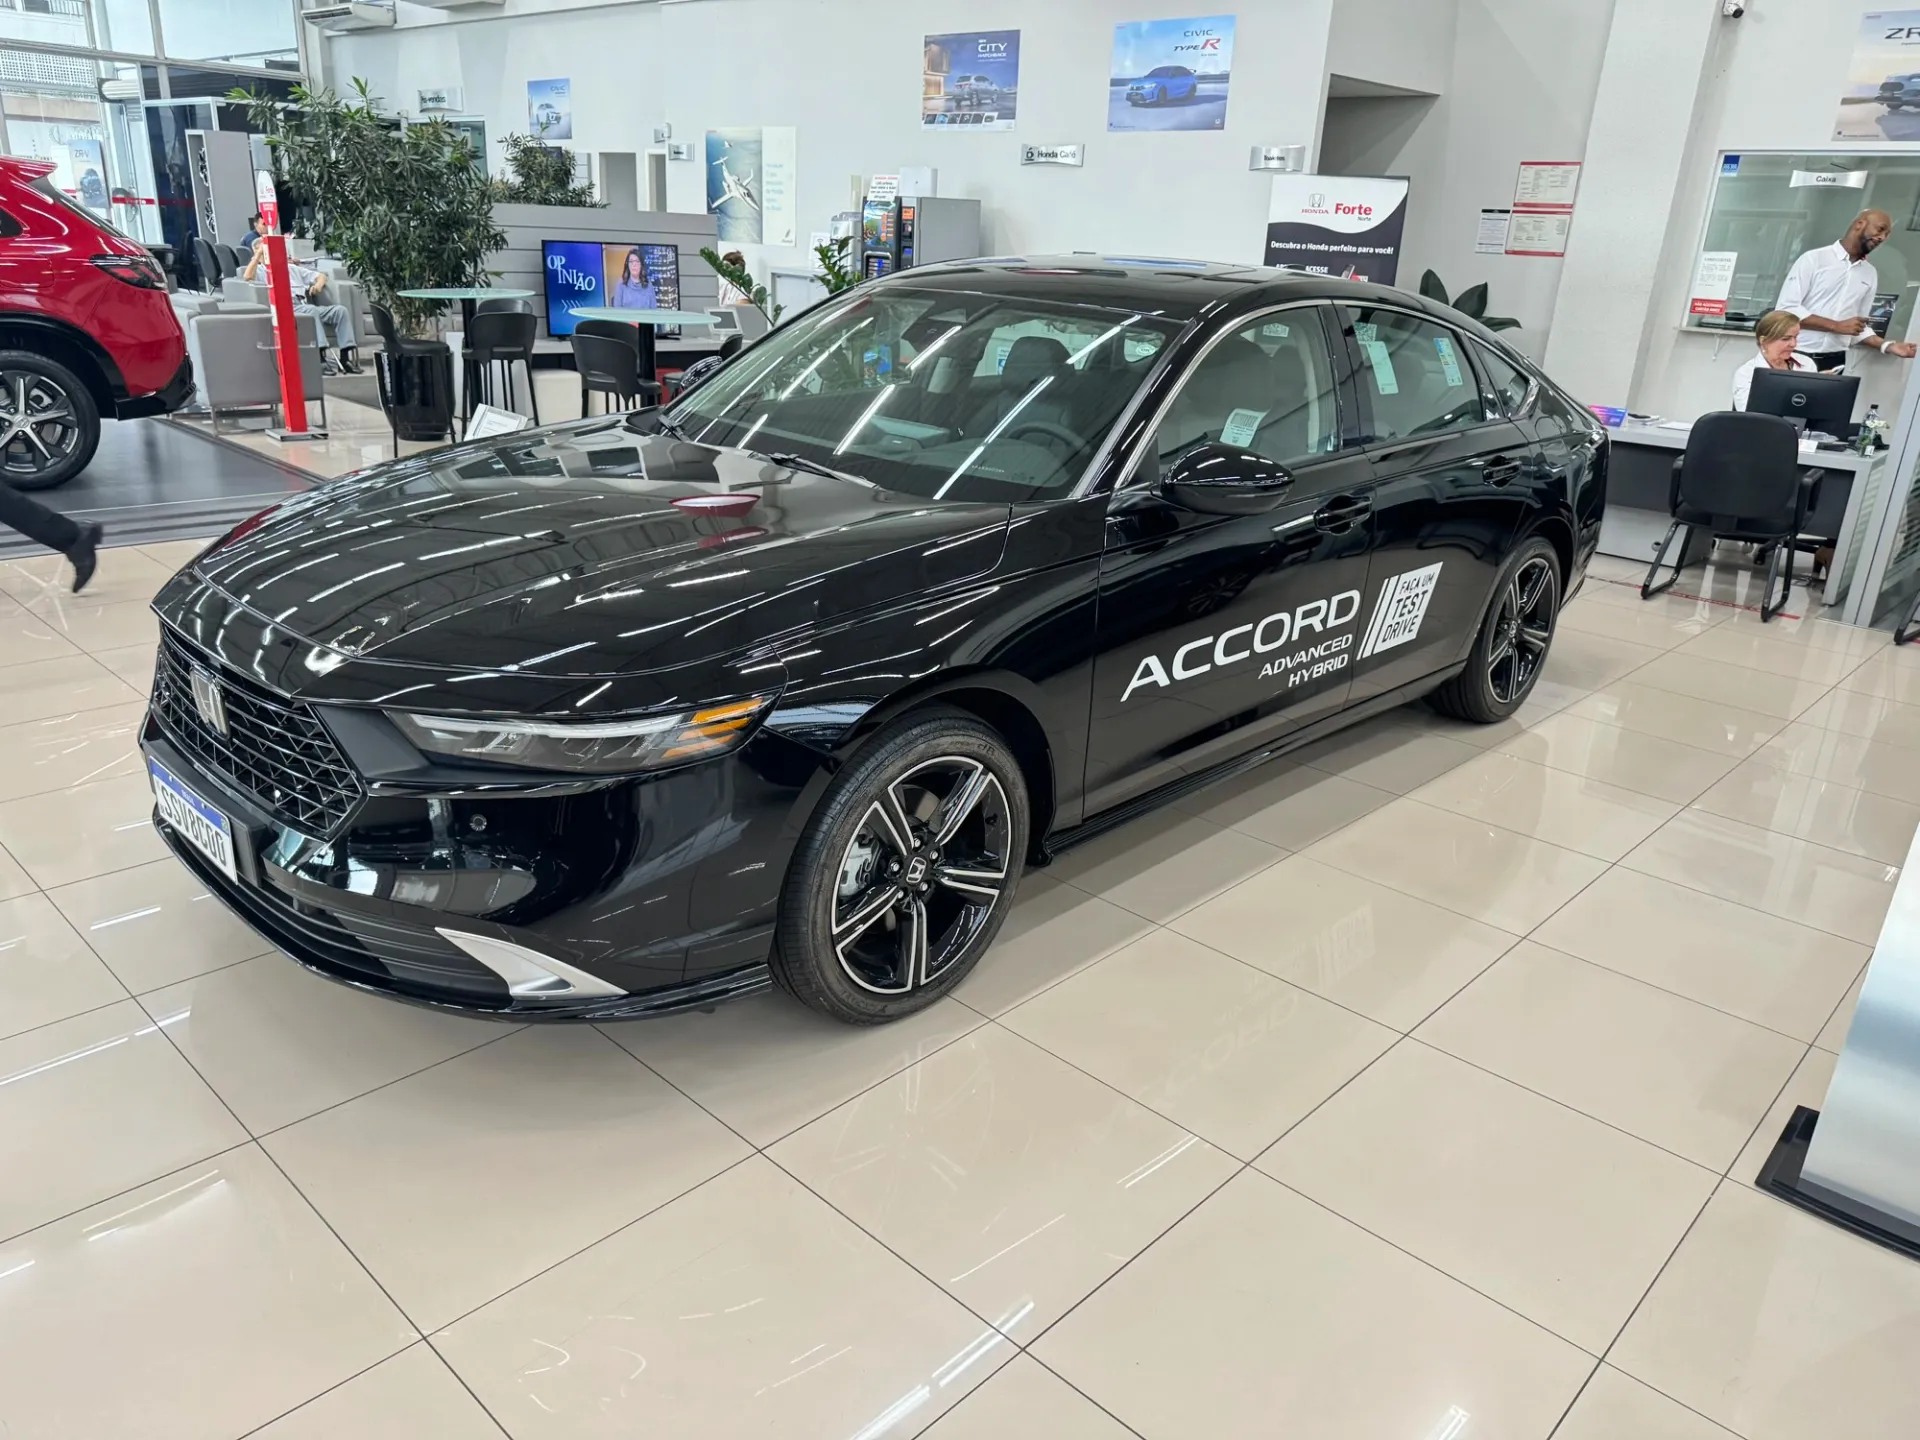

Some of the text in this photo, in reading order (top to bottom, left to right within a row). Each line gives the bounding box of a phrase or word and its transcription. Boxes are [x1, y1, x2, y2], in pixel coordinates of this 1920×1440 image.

[1183, 29, 1213, 38] CIVIC
[977, 42, 1008, 53] CITY
[1173, 38, 1221, 52] TYPE R
[1037, 150, 1077, 159] Honda Café
[1815, 174, 1837, 184] Caixa
[1334, 202, 1373, 216] Forte
[1270, 240, 1301, 251] Descubra
[1307, 242, 1329, 252] Honda
[1329, 243, 1357, 254] perfeito
[1357, 246, 1374, 255] para
[1374, 246, 1394, 255] você!
[1305, 265, 1328, 273] ACESSE
[1399, 571, 1436, 595] FAÇA UM
[1391, 589, 1429, 621] TEST
[1381, 614, 1419, 644] DRIVE
[1120, 589, 1362, 703] ACCORD
[1257, 633, 1353, 680] ADVANCED
[1288, 653, 1349, 688] HYBRID
